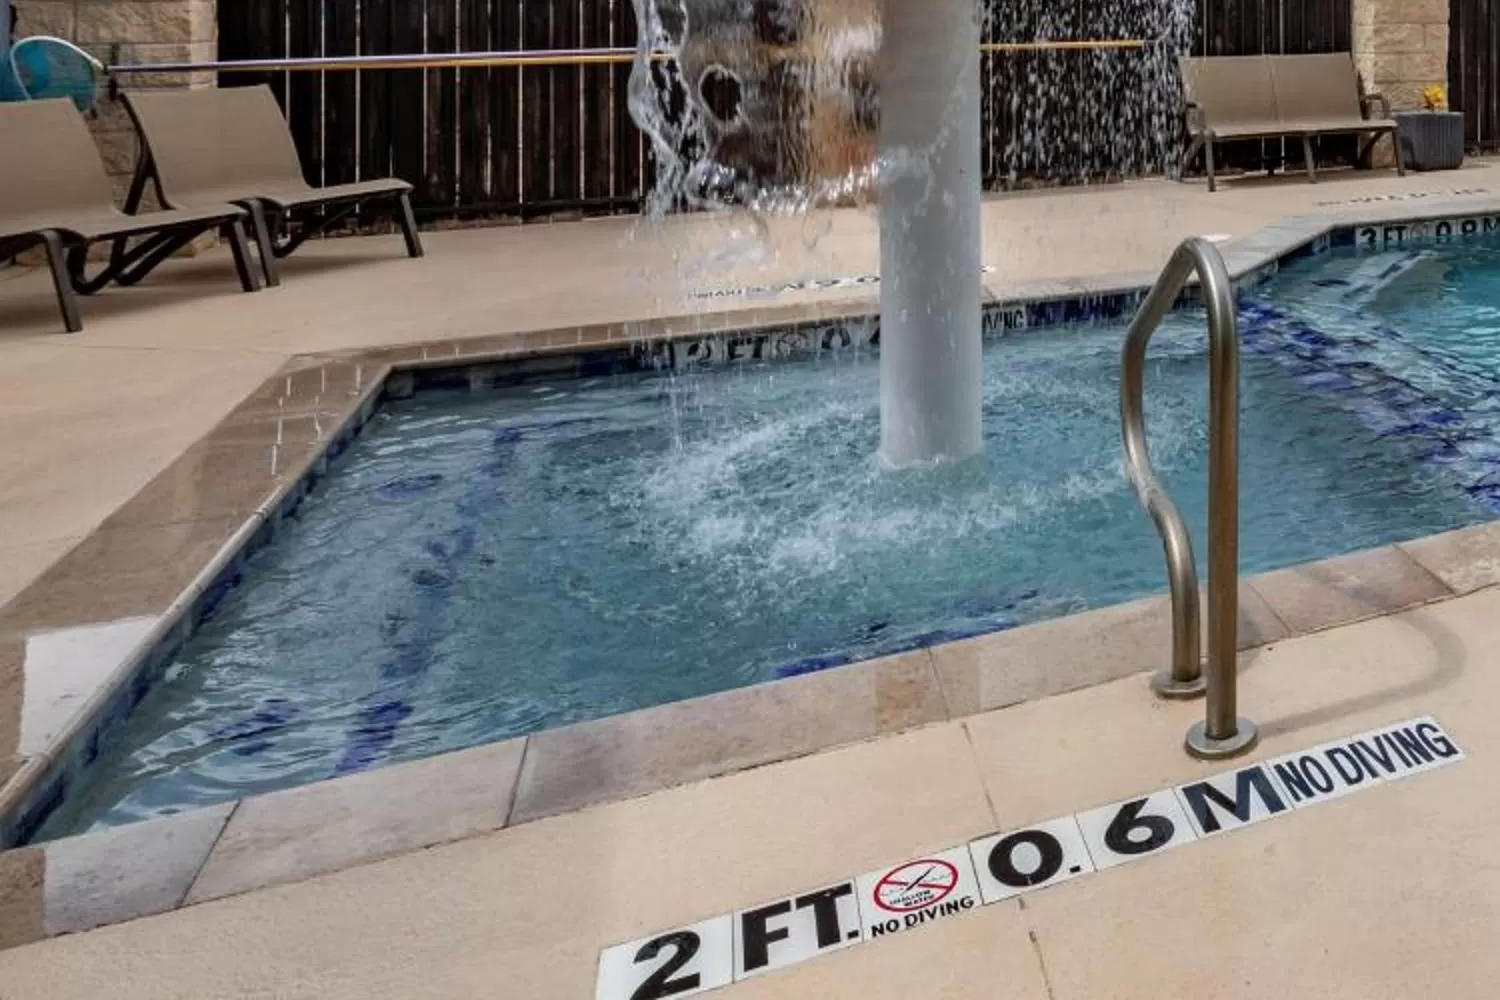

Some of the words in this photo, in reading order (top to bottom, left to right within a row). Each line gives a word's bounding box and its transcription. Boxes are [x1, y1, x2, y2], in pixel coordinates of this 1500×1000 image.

[630, 930, 701, 1000] 2
[742, 883, 859, 972] FT.
[1273, 755, 1335, 803] NO
[1324, 723, 1460, 786] DIVING
[871, 919, 899, 938] NO
[904, 896, 975, 929] DIVING
